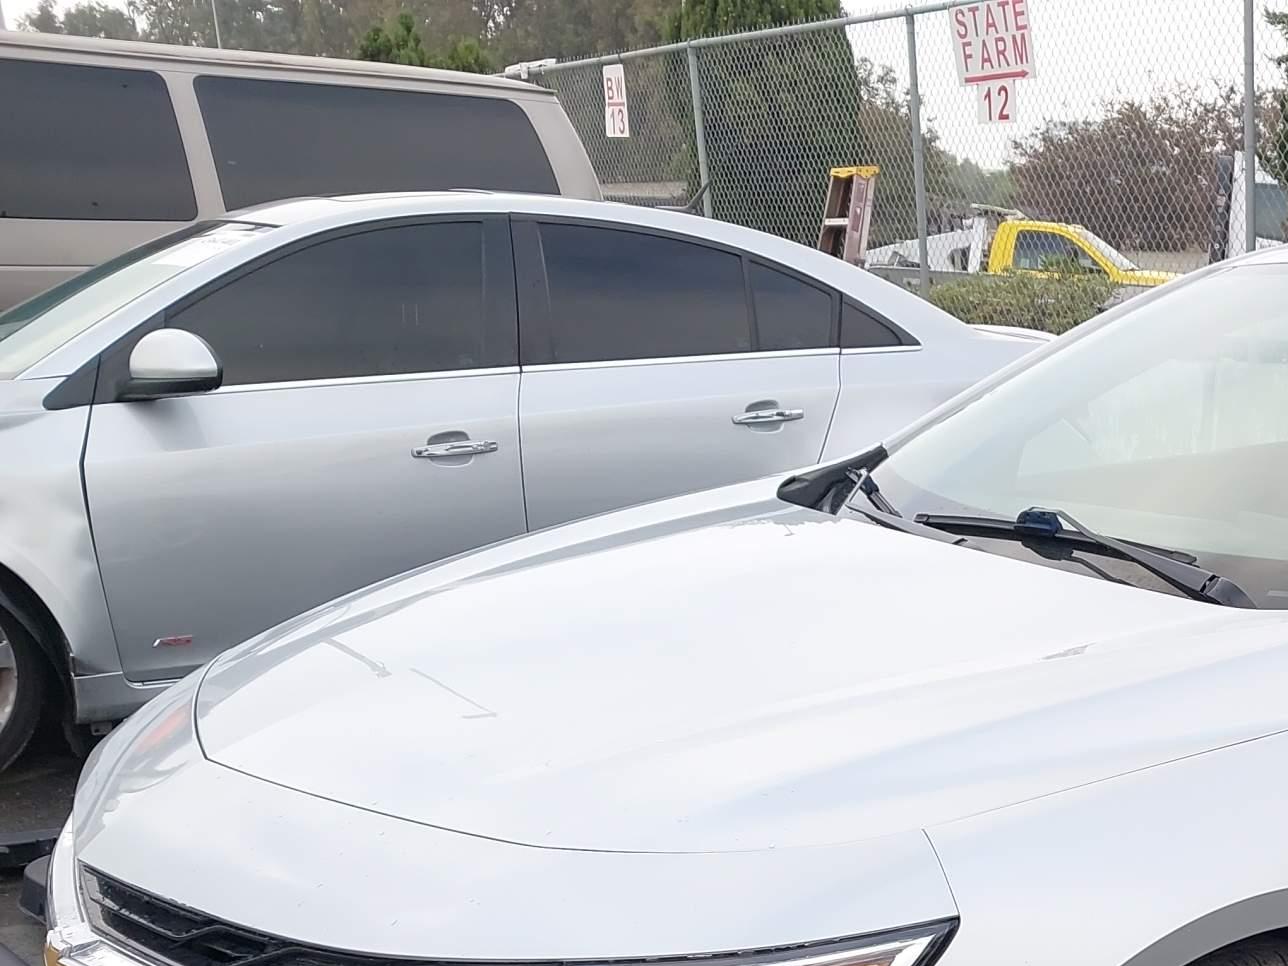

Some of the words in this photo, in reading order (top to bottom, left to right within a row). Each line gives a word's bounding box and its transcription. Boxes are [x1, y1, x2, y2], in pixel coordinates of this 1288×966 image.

[955, 0, 1028, 39] STATE
[961, 33, 1029, 72] FARM
[606, 76, 623, 100] BW
[983, 85, 1010, 121] 12
[610, 108, 625, 135] 13
